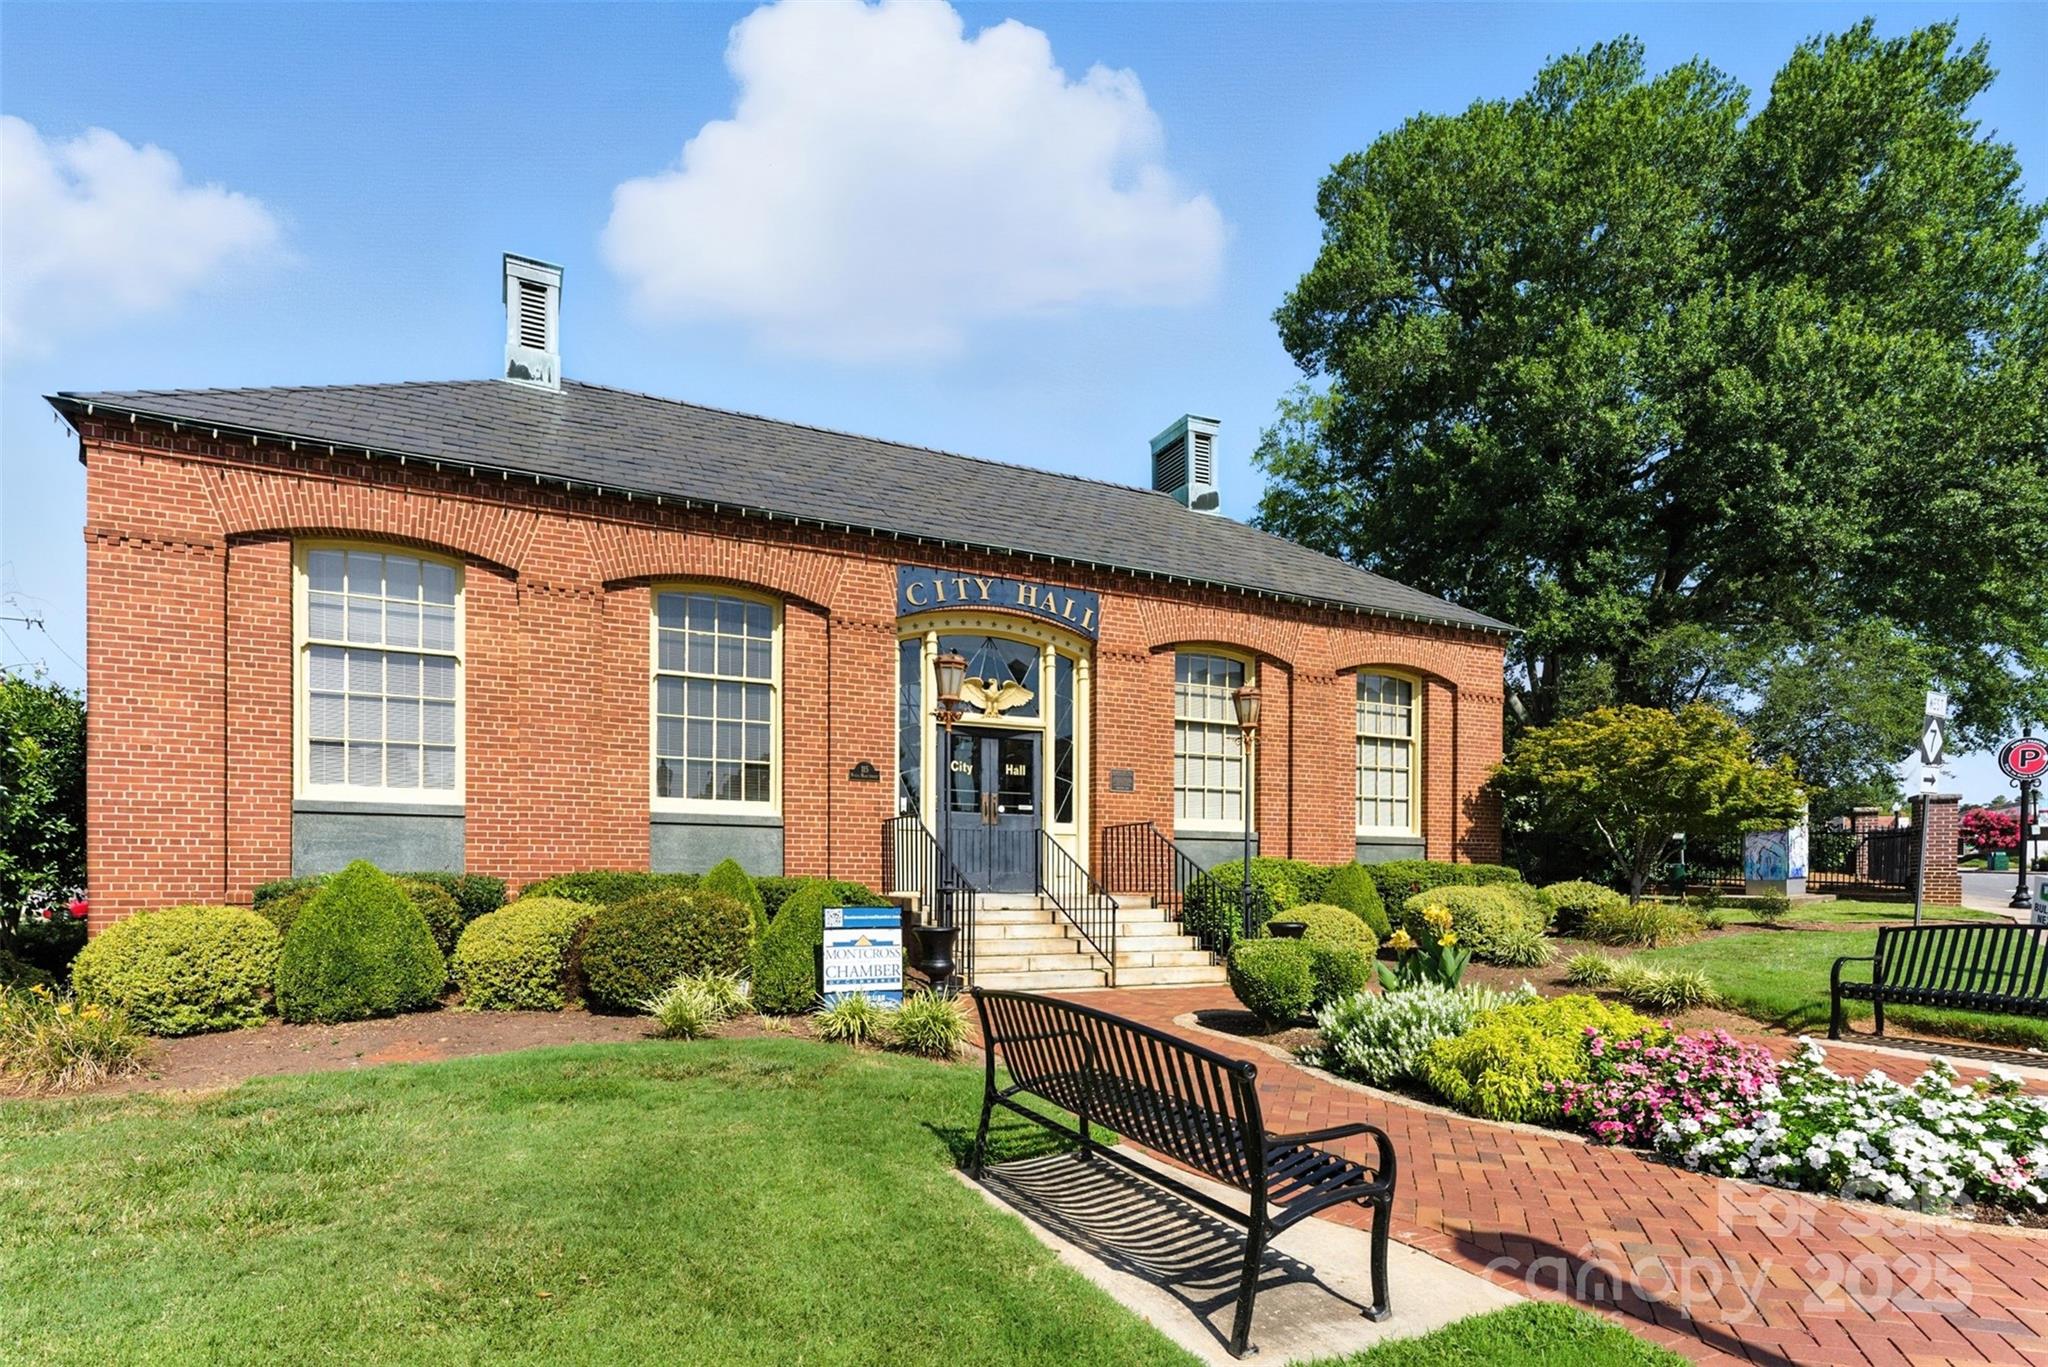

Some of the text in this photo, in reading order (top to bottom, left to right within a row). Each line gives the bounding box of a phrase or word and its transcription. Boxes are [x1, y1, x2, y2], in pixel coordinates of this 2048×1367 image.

[906, 577, 1095, 632] CITY HALL
[1930, 729, 1937, 753] 7
[2020, 749, 2041, 767] P
[950, 760, 1026, 776] City Hall
[825, 947, 901, 960] MONTCROSS
[825, 963, 901, 978] CHAMBER
